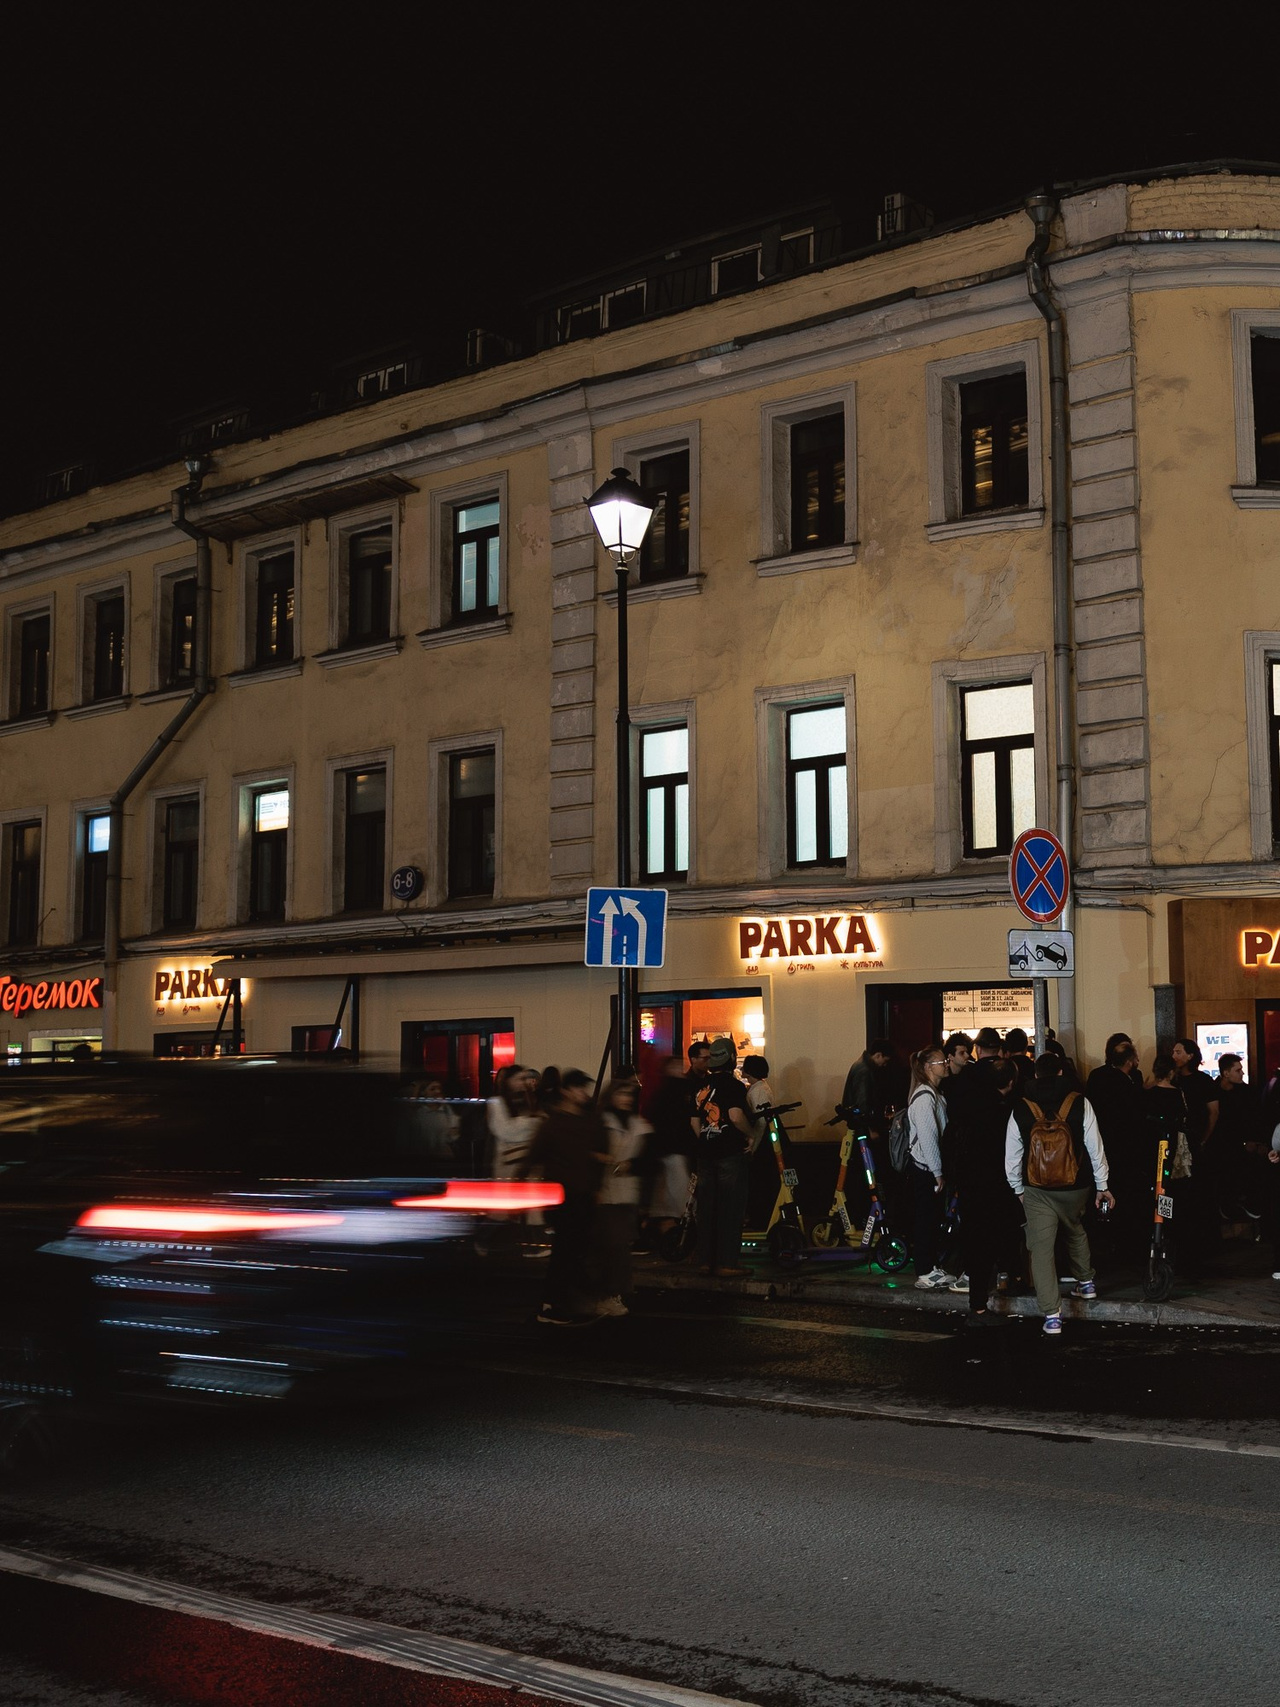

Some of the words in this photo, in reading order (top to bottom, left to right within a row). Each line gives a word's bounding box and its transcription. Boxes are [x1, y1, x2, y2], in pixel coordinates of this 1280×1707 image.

[393, 871, 413, 890] 6-8
[739, 915, 877, 959] PARKA
[796, 963, 815, 971] ГРИЛЬ
[853, 960, 884, 968] КУЛЬТУРА
[1206, 1035, 1230, 1045] WE
[1214, 1051, 1245, 1061] AE
